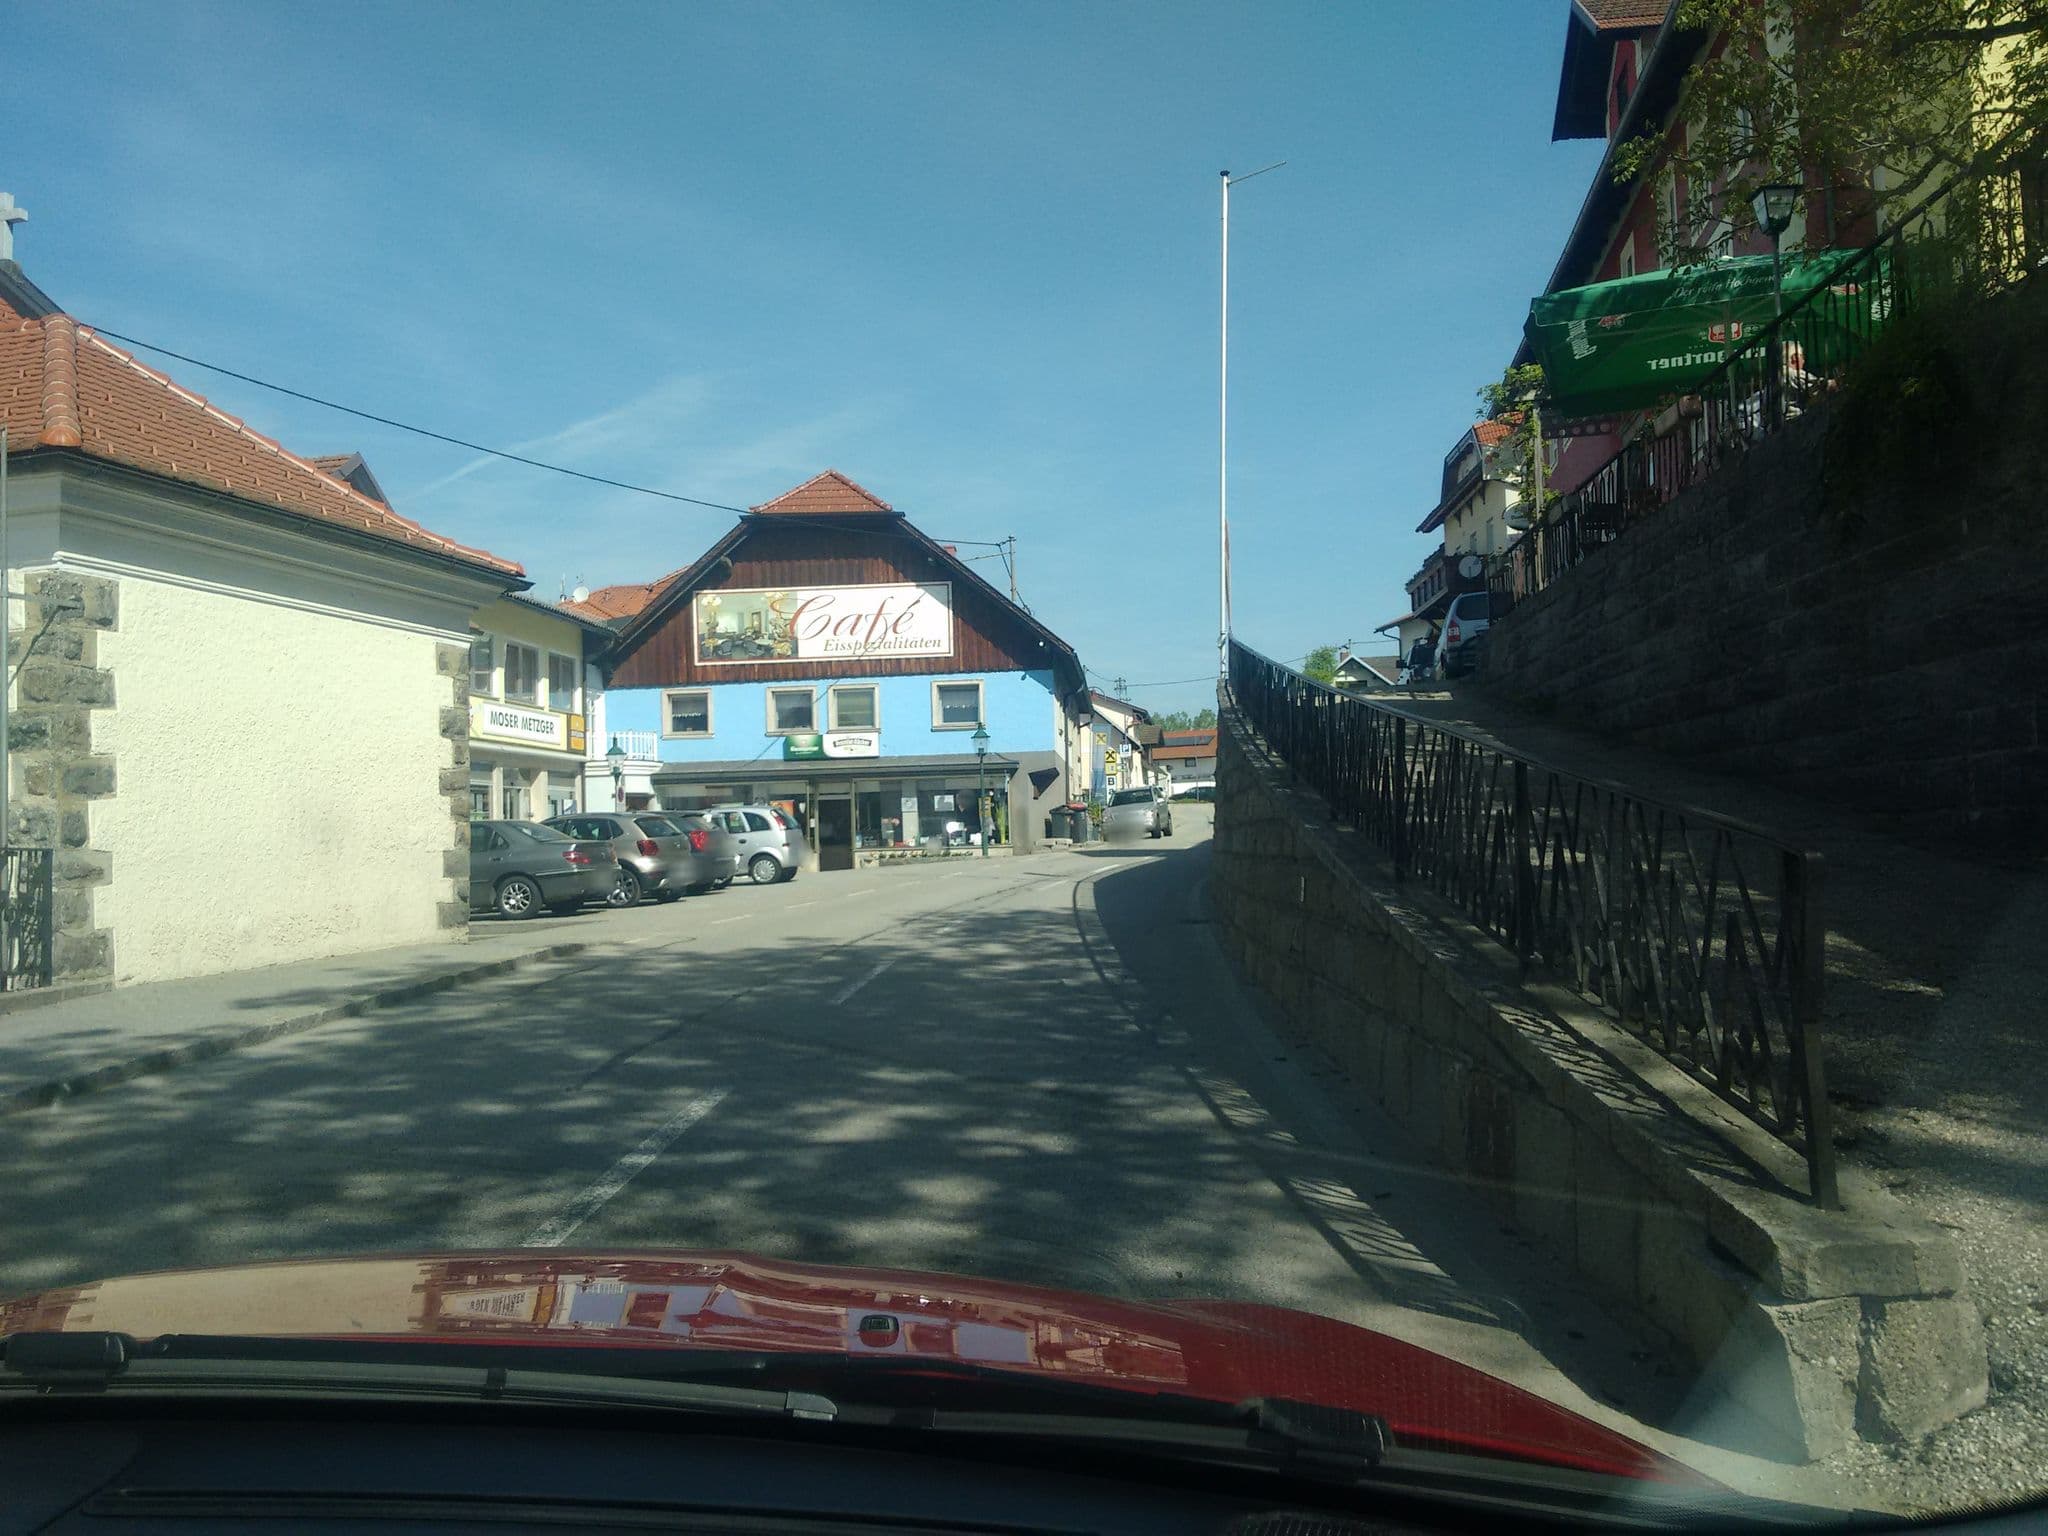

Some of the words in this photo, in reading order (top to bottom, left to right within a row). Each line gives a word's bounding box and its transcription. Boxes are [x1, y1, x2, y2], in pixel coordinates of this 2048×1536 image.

[770, 594, 920, 649] Café
[824, 638, 942, 653] Eisspezialitäten
[490, 711, 518, 728] MOSER
[521, 717, 554, 735] METZGER
